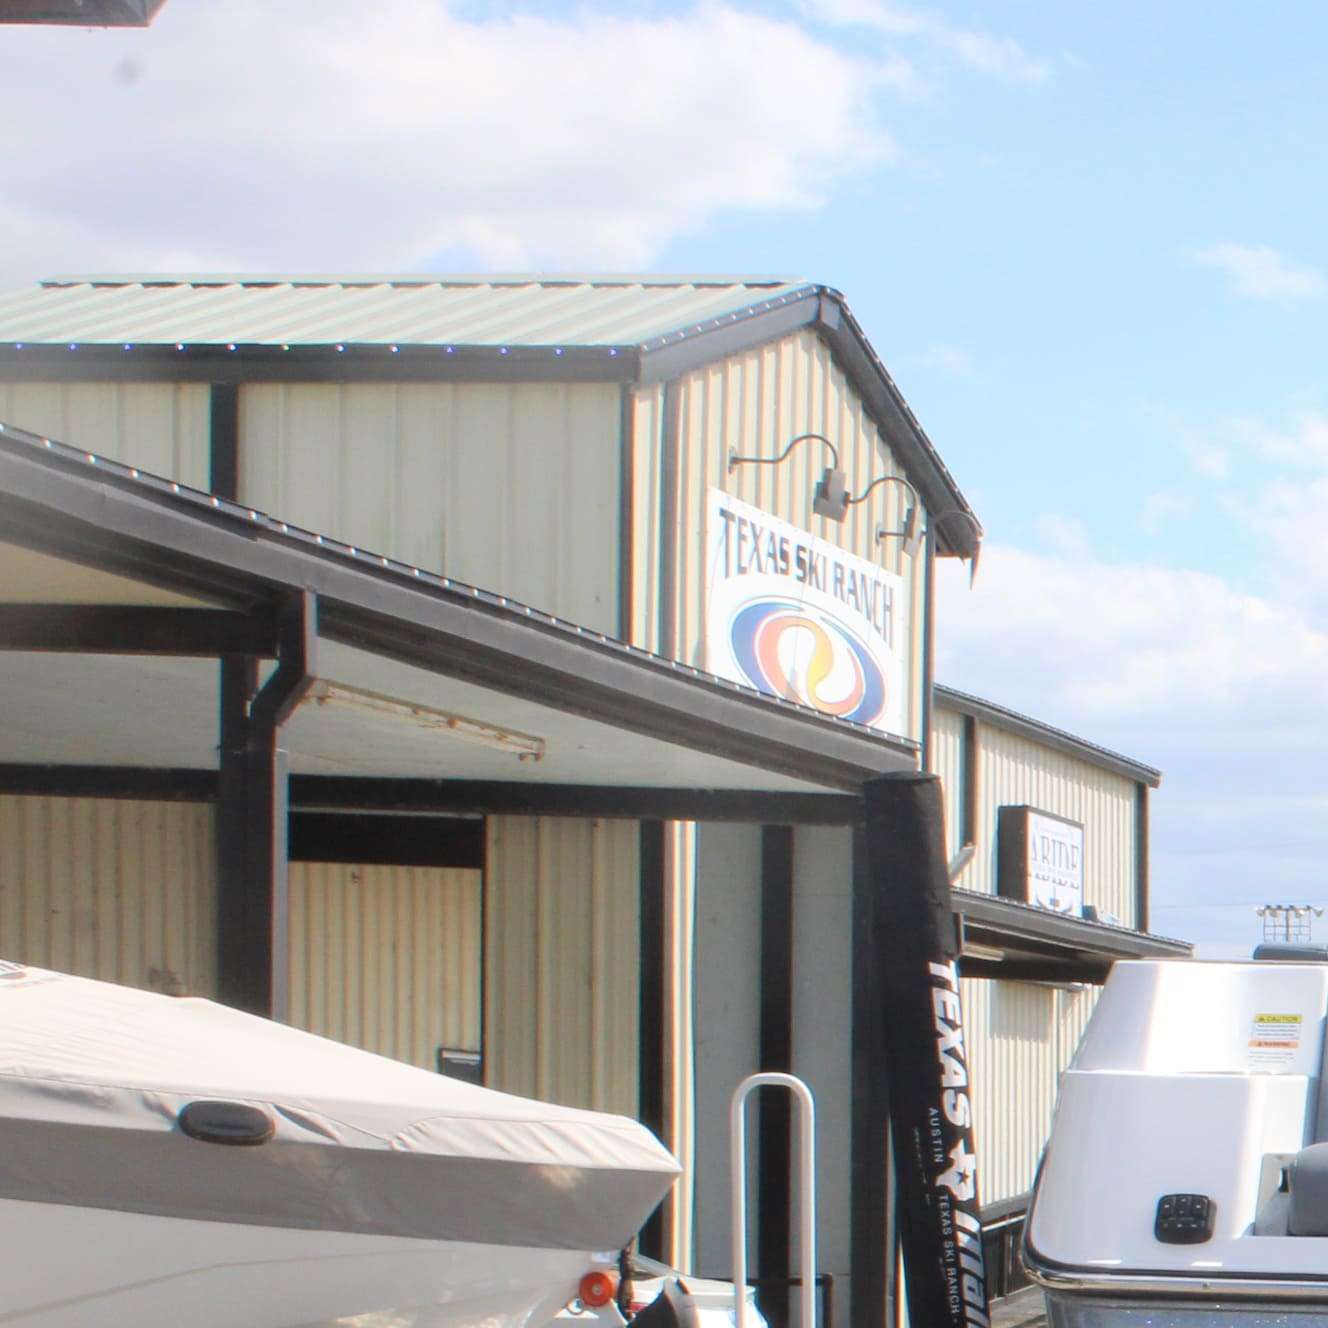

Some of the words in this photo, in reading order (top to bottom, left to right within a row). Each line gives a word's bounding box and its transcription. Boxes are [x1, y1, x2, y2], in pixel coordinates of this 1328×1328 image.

[719, 507, 790, 579] TEXAS
[795, 544, 828, 593] SKI
[834, 561, 894, 650] RANCH
[928, 959, 972, 1129] TEXAS
[928, 1107, 944, 1164] AUSTIN
[938, 1194, 952, 1236] TEXAS
[943, 1239, 955, 1263] SKI
[946, 1267, 960, 1314] RANCH
